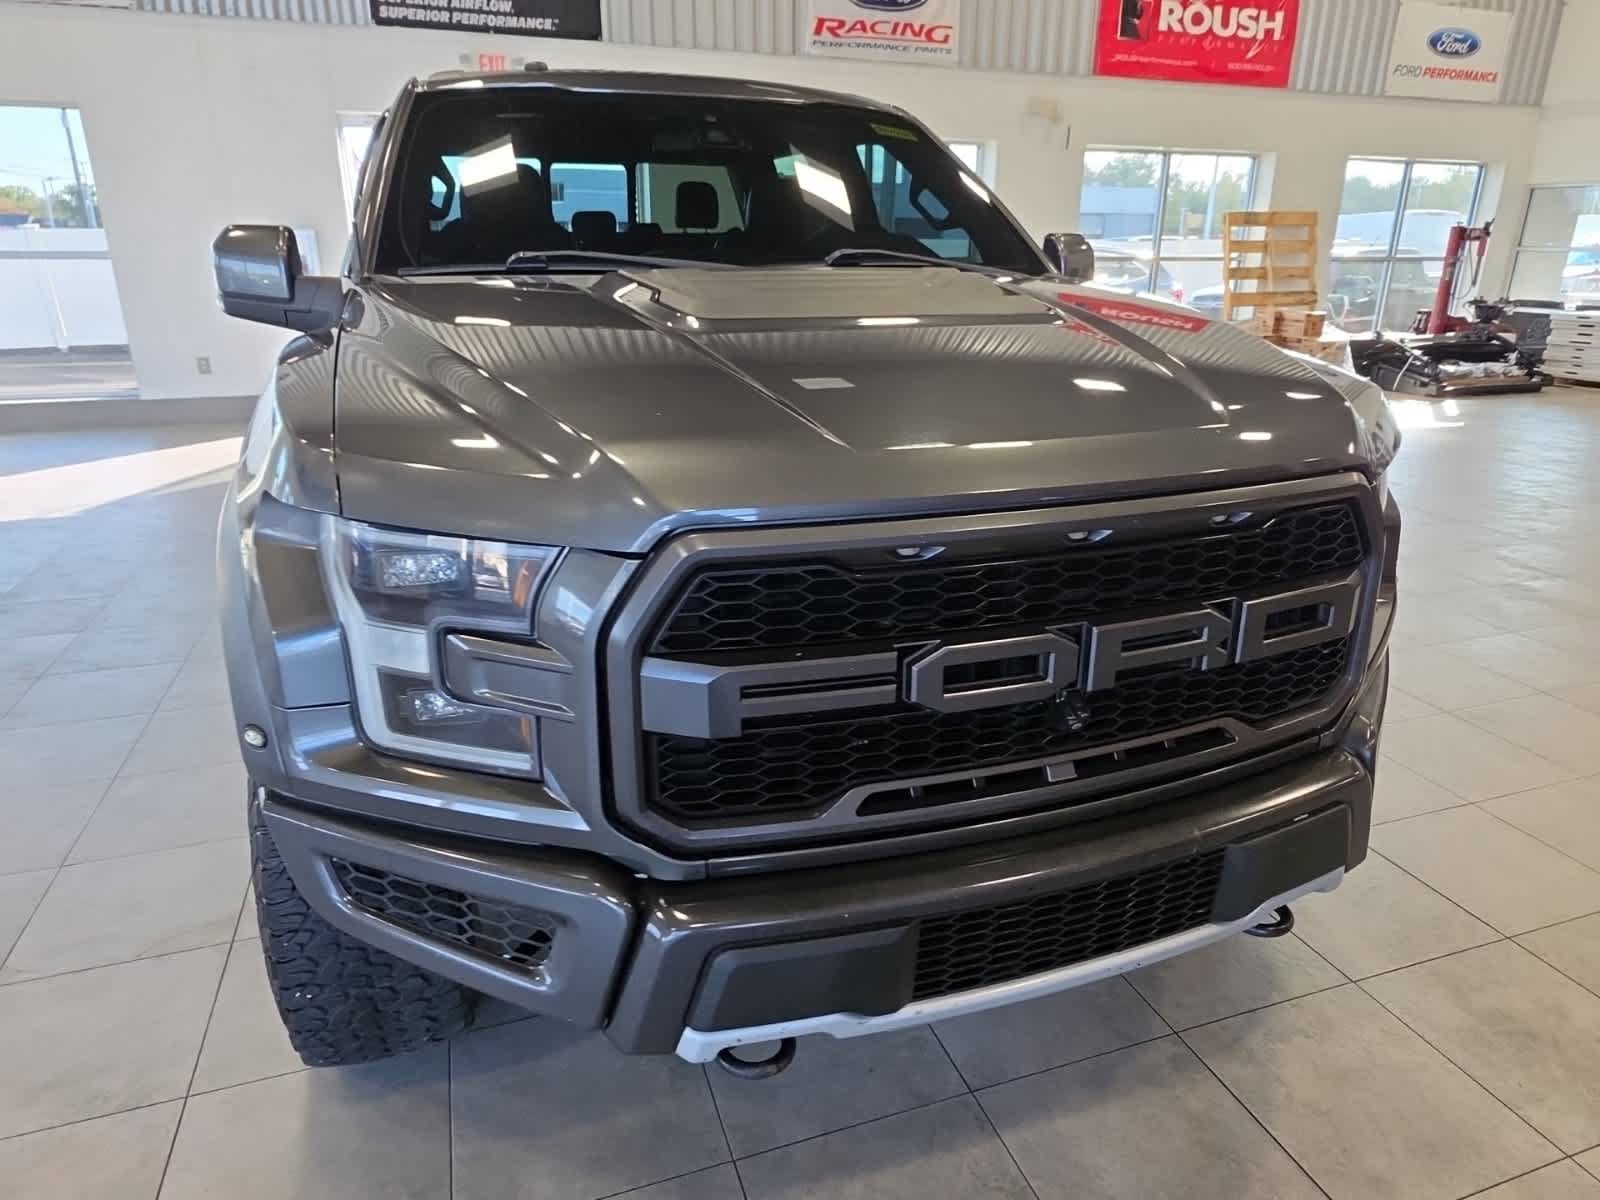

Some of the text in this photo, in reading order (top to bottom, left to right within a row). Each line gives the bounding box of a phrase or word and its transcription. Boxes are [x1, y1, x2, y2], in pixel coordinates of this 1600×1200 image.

[379, 5, 450, 24] SUPERIOR
[1158, 0, 1285, 41] ROUSH
[813, 17, 953, 44] RACING
[812, 39, 953, 55] PERFORMANCE PARTS
[1436, 31, 1473, 54] Ford
[479, 54, 505, 71] EXIT
[1393, 64, 1499, 83] FORD PERFORMANCE
[640, 576, 1363, 739] FORD
